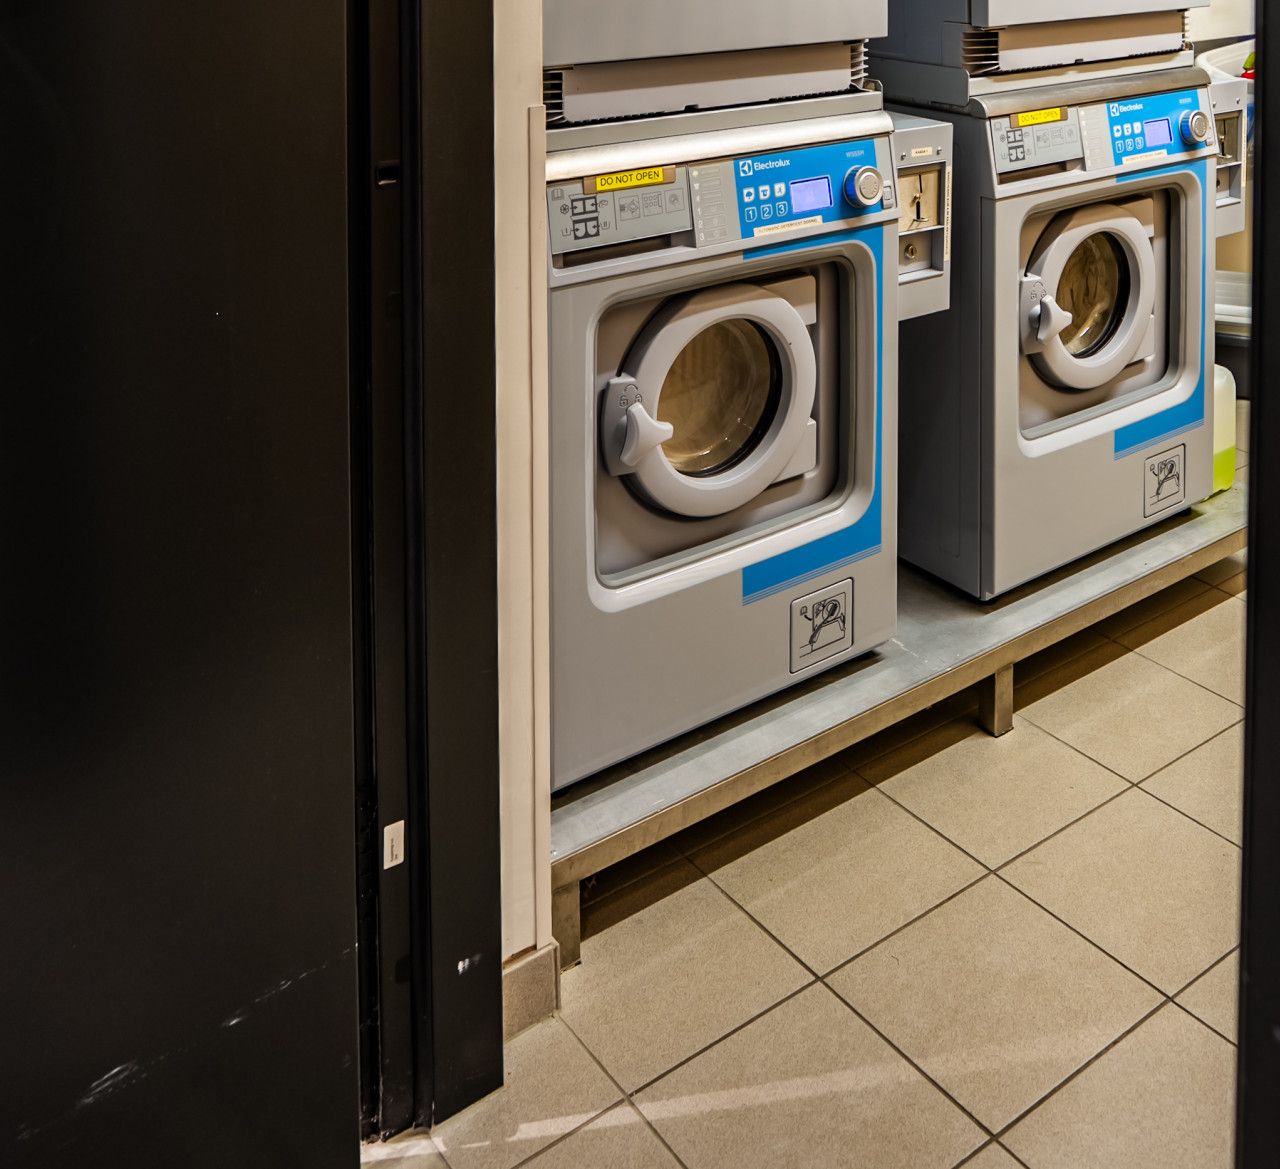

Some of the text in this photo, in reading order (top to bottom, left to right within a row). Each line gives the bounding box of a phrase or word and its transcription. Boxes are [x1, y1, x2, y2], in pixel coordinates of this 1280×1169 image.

[1119, 103, 1143, 113] Electrolux
[1021, 110, 1058, 123] DO NOT OPEN
[754, 159, 791, 171] Electrolux
[600, 170, 660, 187] DO NOT OPEN
[763, 205, 770, 216] 2
[779, 203, 785, 214] 3
